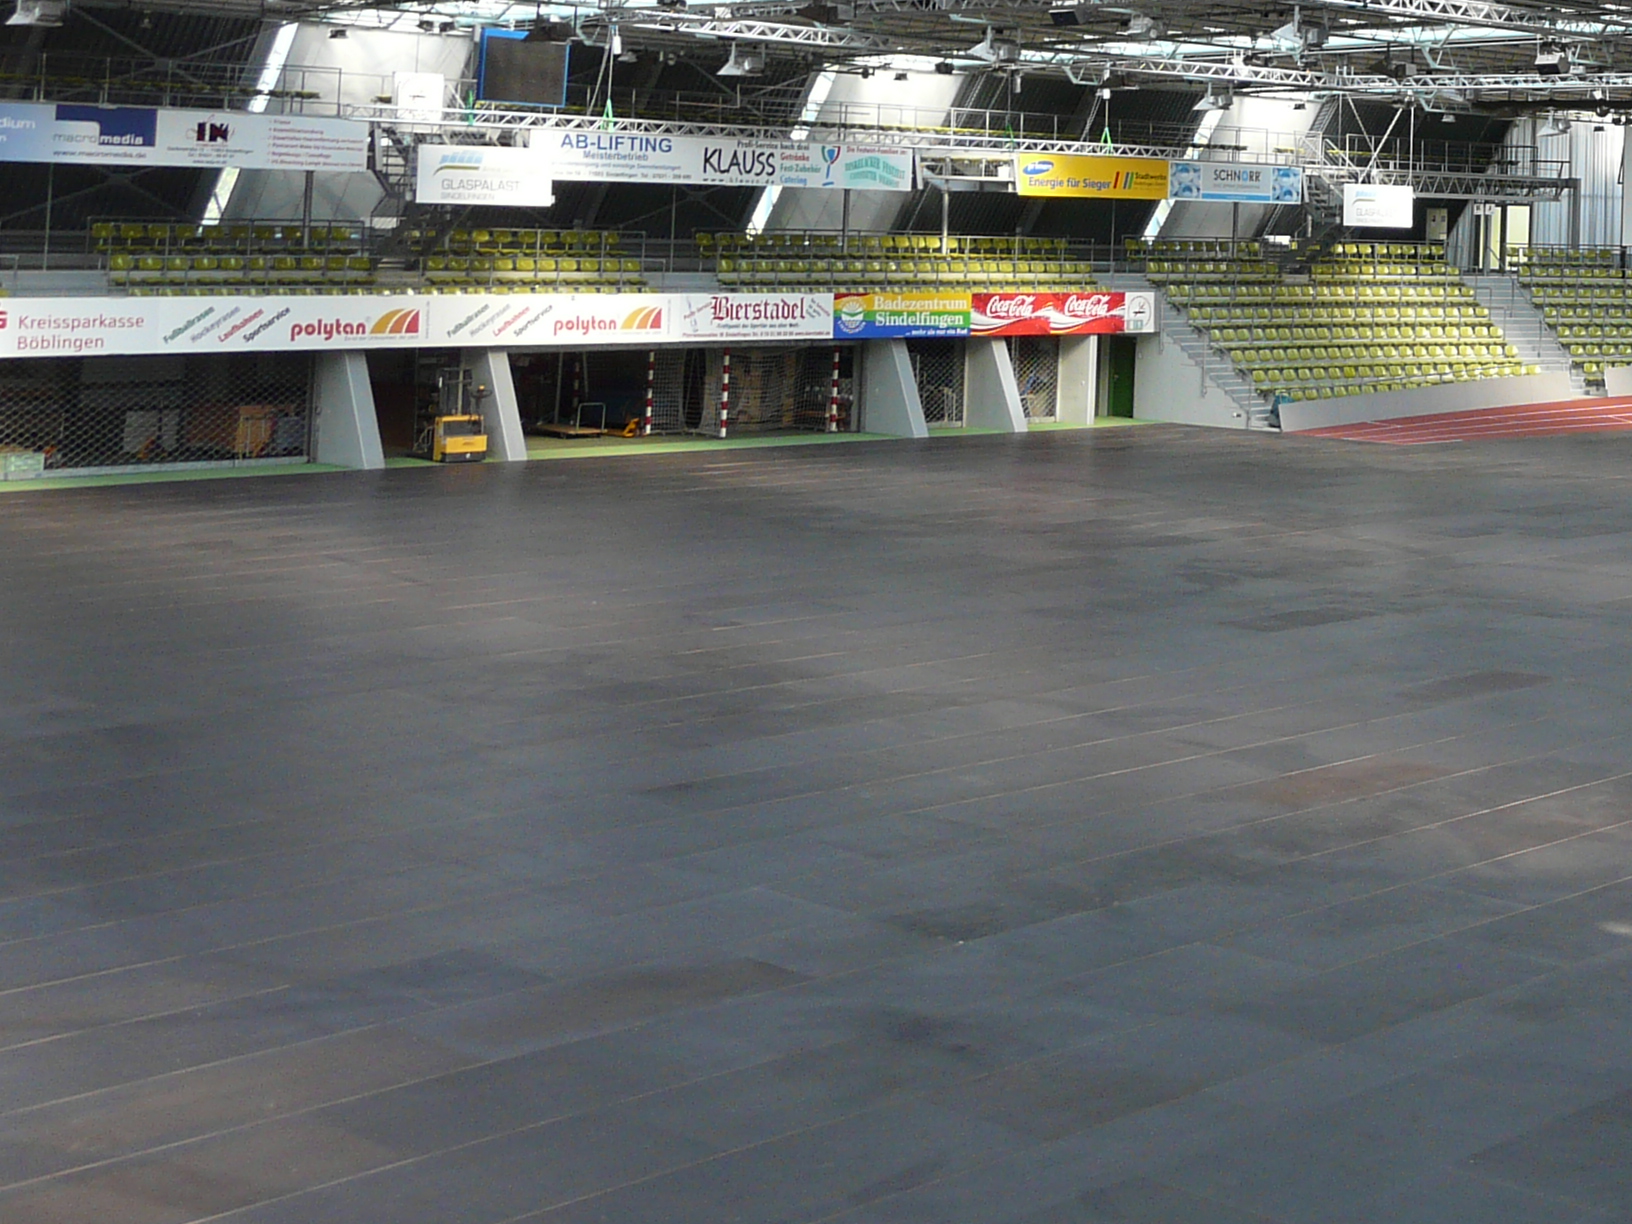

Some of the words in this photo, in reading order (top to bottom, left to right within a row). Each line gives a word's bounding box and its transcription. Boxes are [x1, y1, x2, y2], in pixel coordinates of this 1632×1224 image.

[561, 133, 673, 153] AB-LIFTING
[583, 150, 649, 161] Meisterbetrieb
[703, 147, 776, 177] KLAUSS
[441, 178, 520, 191] GLASPALAST
[1028, 176, 1065, 188] Energie
[1066, 178, 1080, 188] für
[1082, 178, 1111, 190] Sieger
[711, 296, 806, 322] Bierstadel
[874, 296, 967, 310] Badezentrum
[18, 313, 145, 332] Kreissparkasse
[243, 307, 291, 344] Sportservice
[553, 315, 617, 336] polytan
[875, 311, 964, 328] Sindelfingen
[290, 318, 367, 342] polytan
[17, 334, 104, 352] Böblingen
